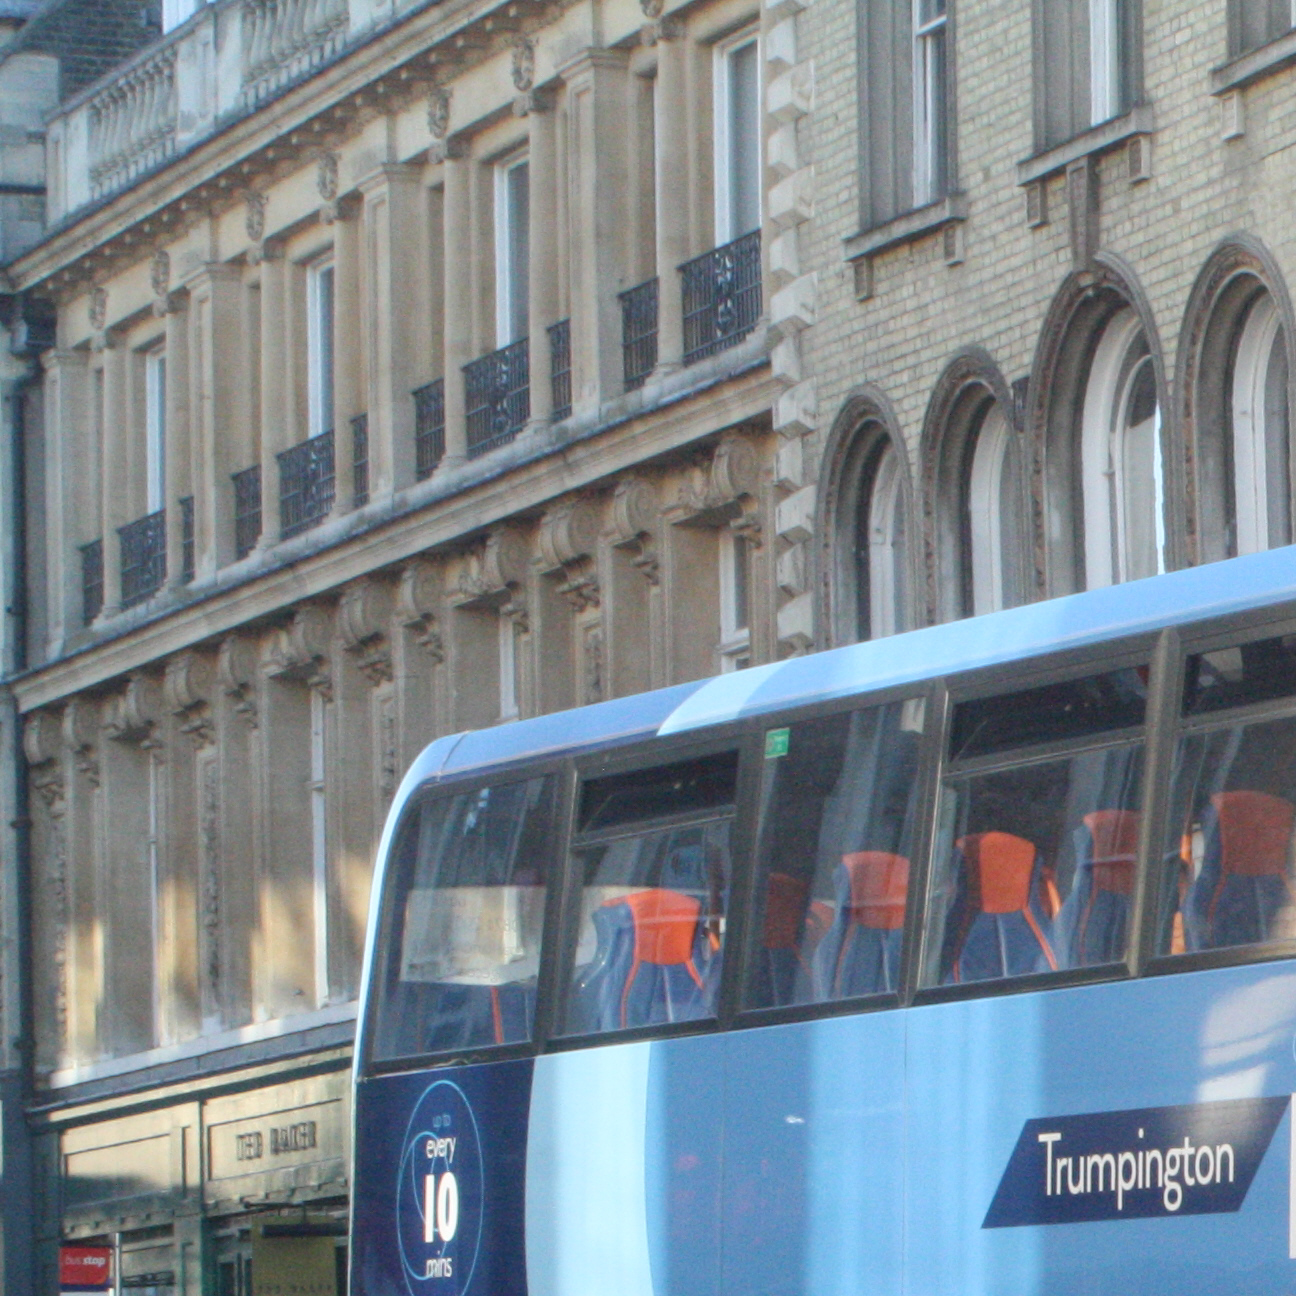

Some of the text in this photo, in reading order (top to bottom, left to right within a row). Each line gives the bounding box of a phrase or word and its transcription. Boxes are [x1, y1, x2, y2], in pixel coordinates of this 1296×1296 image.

[426, 1137, 457, 1164] every
[1037, 1127, 1235, 1211] Trumpington
[424, 1172, 459, 1244] 10
[425, 1249, 453, 1279] mins
